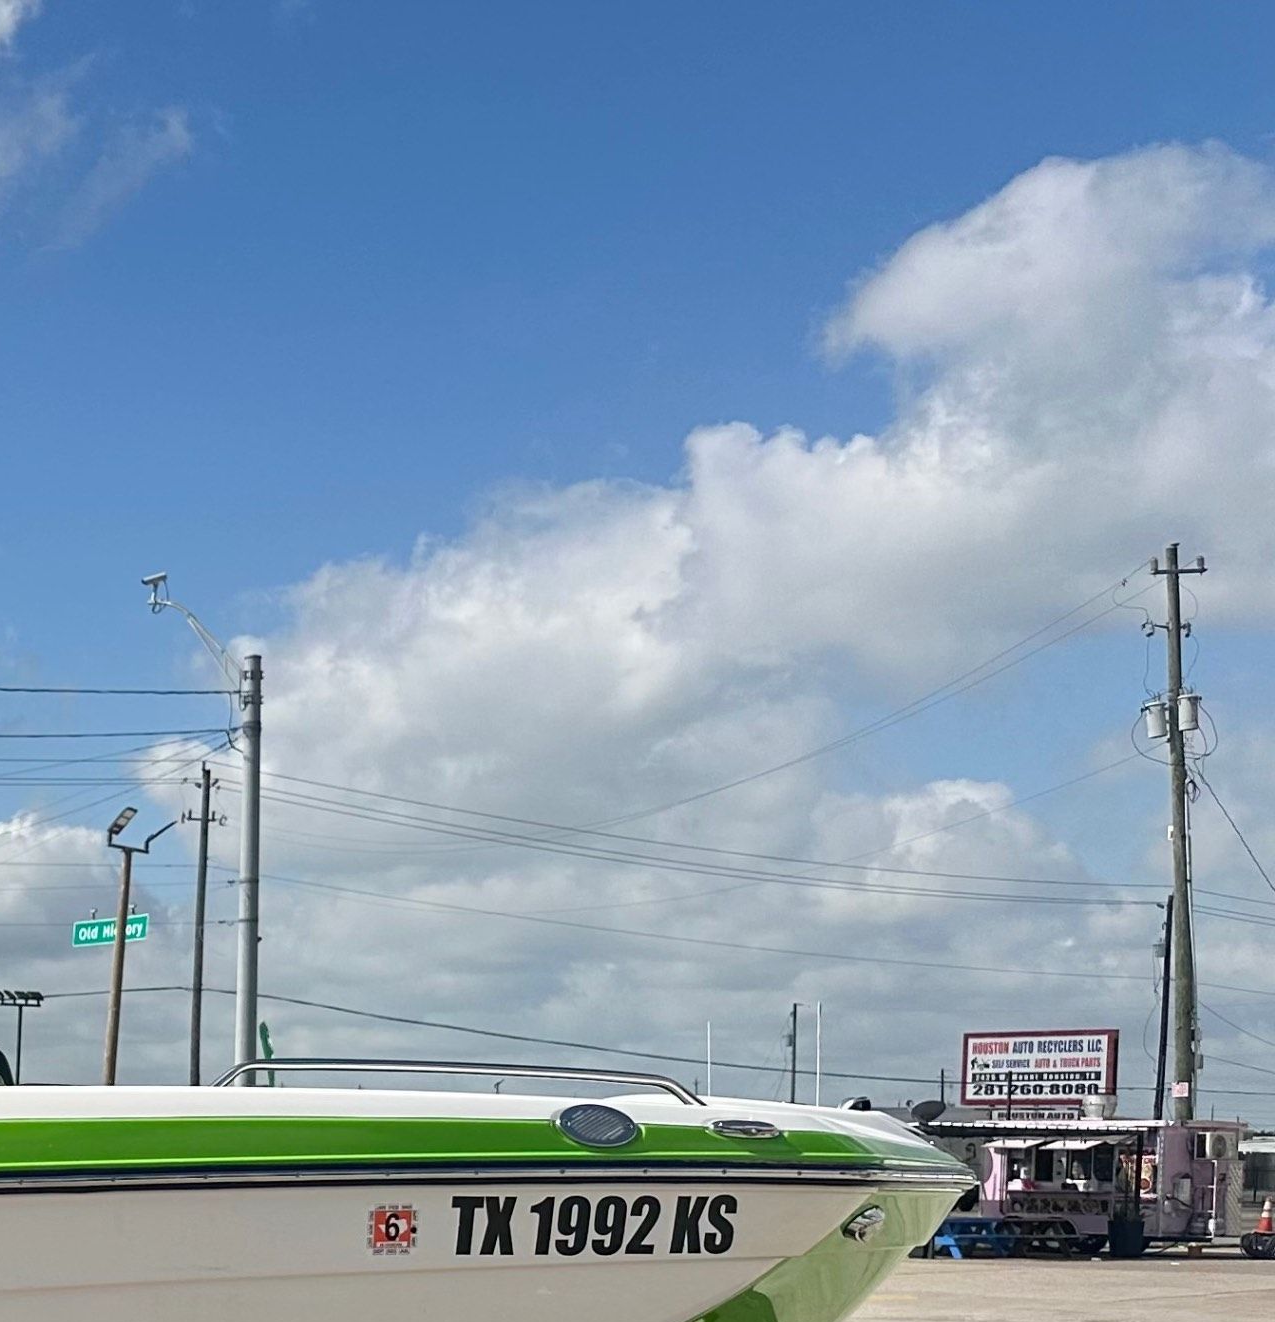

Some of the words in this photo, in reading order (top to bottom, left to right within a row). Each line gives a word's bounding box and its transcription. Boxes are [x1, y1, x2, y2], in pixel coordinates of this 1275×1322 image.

[78, 926, 98, 941] Old
[102, 922, 143, 938] Hicory
[972, 1041, 1010, 1055] HOUSTON
[1012, 1040, 1034, 1054] AUTO
[1037, 1039, 1083, 1053] RECYCLERS
[992, 1059, 1005, 1069] SELF
[1006, 1059, 1030, 1069] SERVICE
[1034, 1058, 1050, 1069] AUTO
[1059, 1057, 1080, 1068] TRUCK
[1081, 1057, 1101, 1068] PARTS
[972, 1083, 1099, 1096] 281.260.8080
[1047, 1112, 1075, 1120] AUTO
[384, 1212, 400, 1242] 6
[451, 1195, 518, 1256] TX
[530, 1195, 661, 1257] 1992
[669, 1194, 738, 1255] KS
